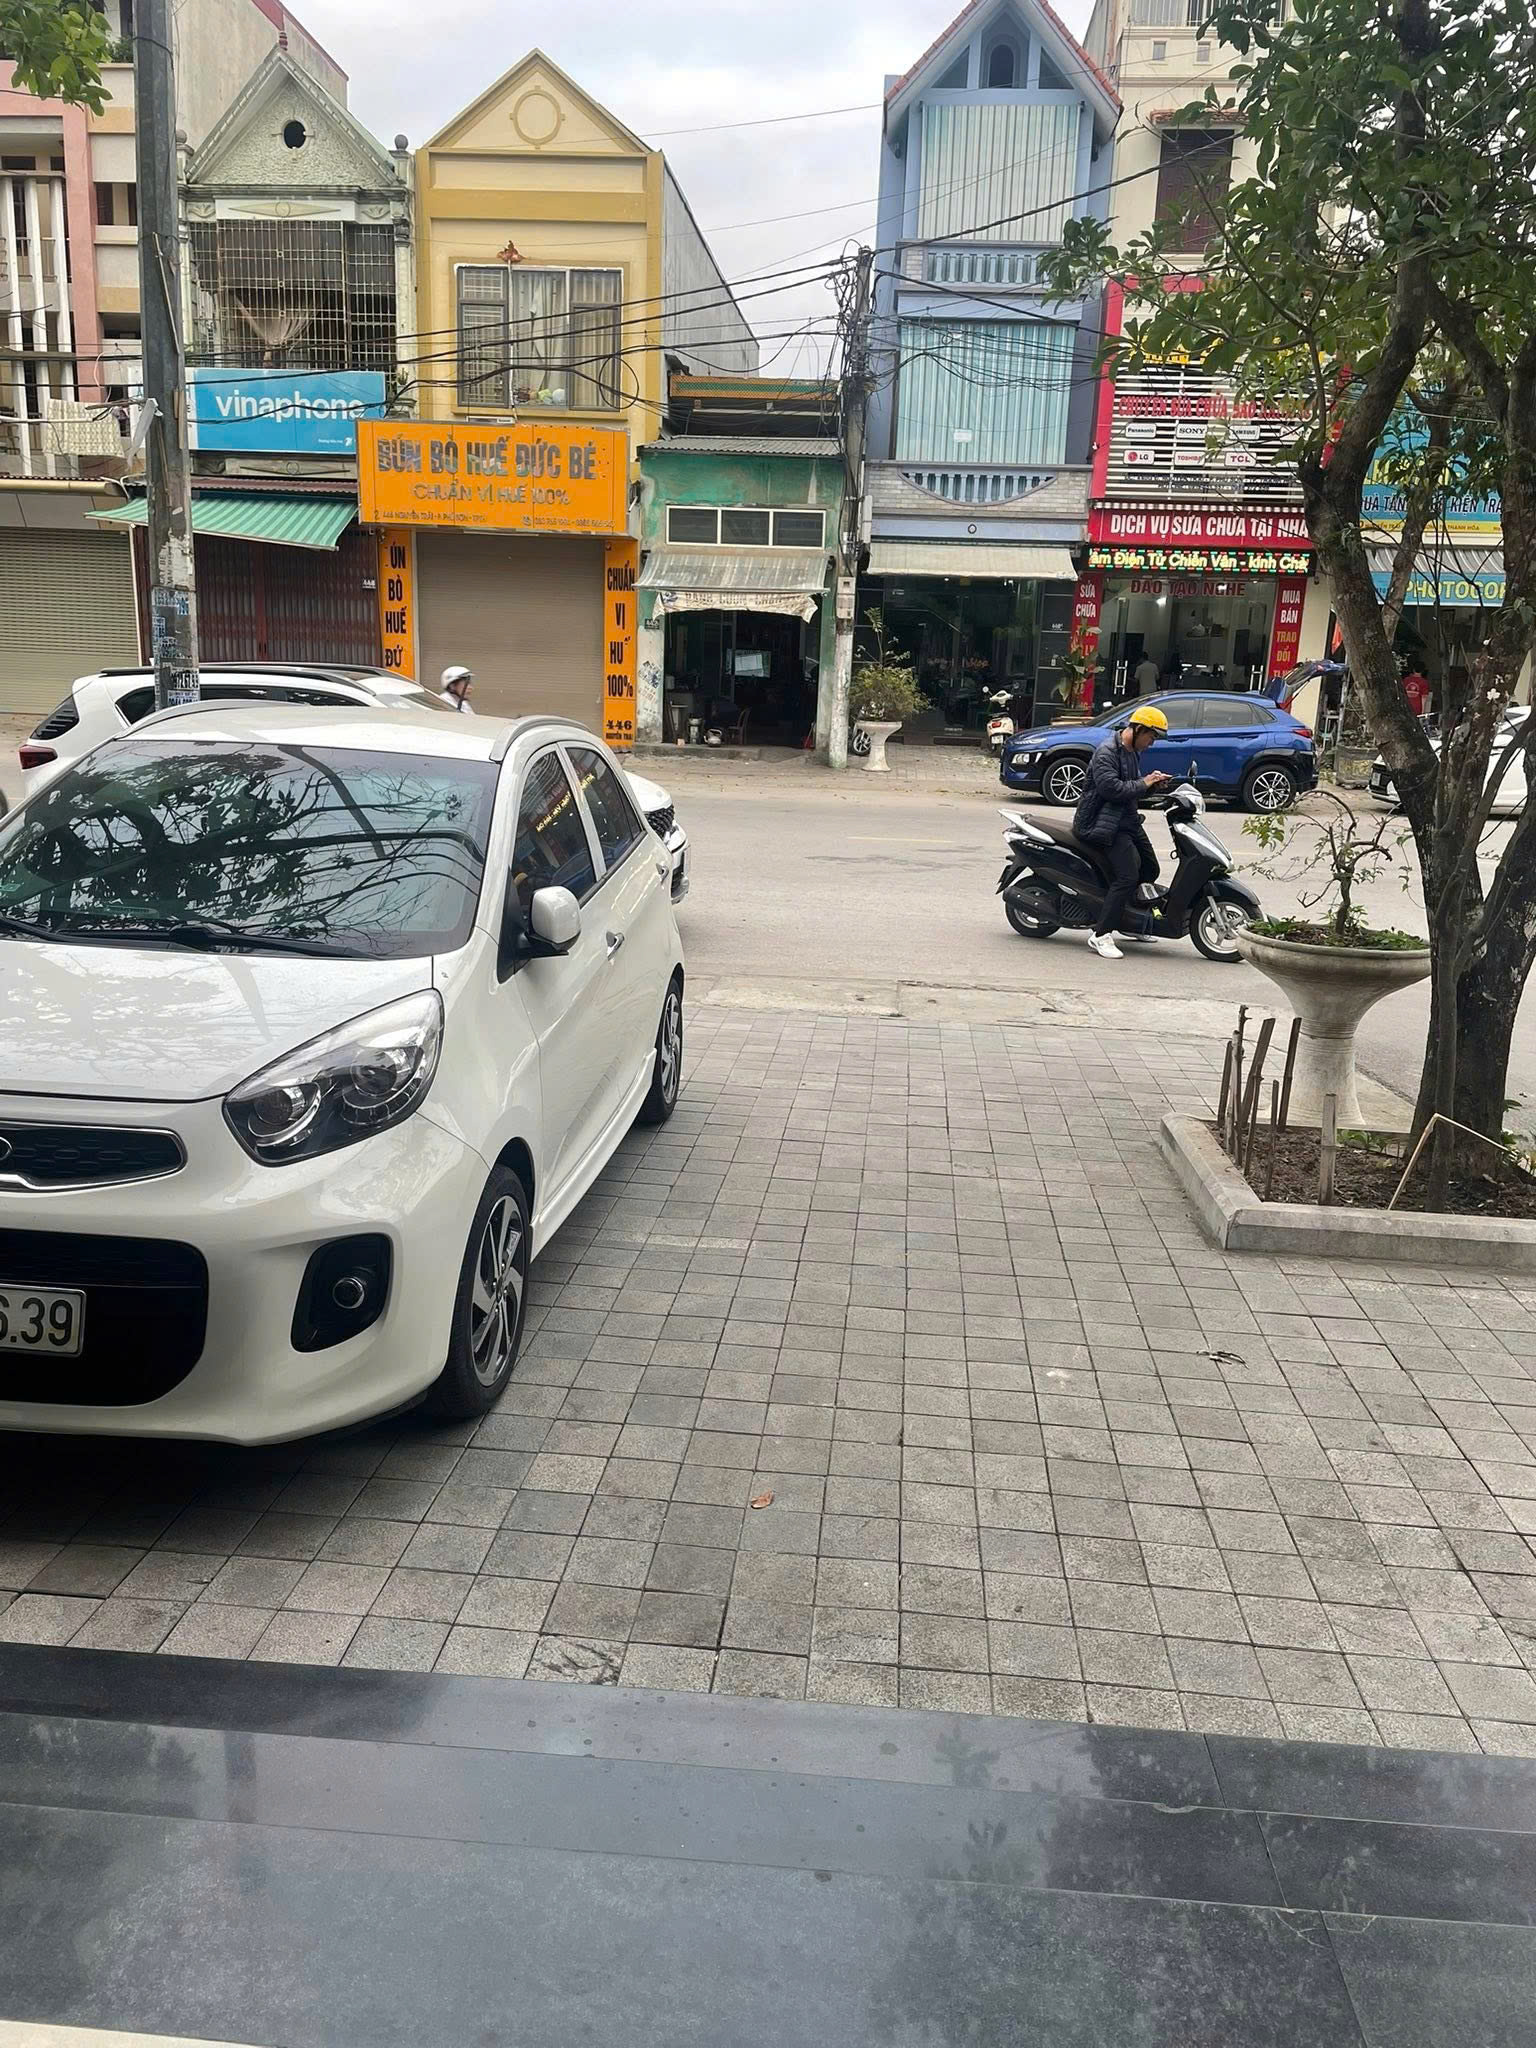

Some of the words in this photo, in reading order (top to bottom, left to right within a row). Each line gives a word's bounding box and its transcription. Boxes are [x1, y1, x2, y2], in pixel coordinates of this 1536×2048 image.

[216, 389, 366, 423] vinaphone
[1178, 426, 1205, 435] SONY
[377, 434, 422, 473] BÚN
[430, 433, 458, 475] BÒ
[466, 436, 511, 477] HUẾ
[515, 437, 561, 479] ĐỨC
[568, 441, 597, 480] BÉ
[1230, 455, 1250, 463] TCL
[1110, 514, 1146, 537] DỊCH
[1151, 515, 1170, 539] VỤ
[1250, 517, 1272, 540] TẠI
[1114, 551, 1145, 567] Điện
[388, 574, 403, 601] BÒ
[1281, 590, 1301, 604] MUA
[385, 606, 407, 634] HUẾ
[615, 602, 625, 630] VỊ
[1280, 607, 1298, 624] BÁN
[1276, 631, 1297, 643] TRAO
[1276, 645, 1291, 662] ĐỔI
[607, 674, 633, 697] 100%
[606, 720, 632, 730] 446
